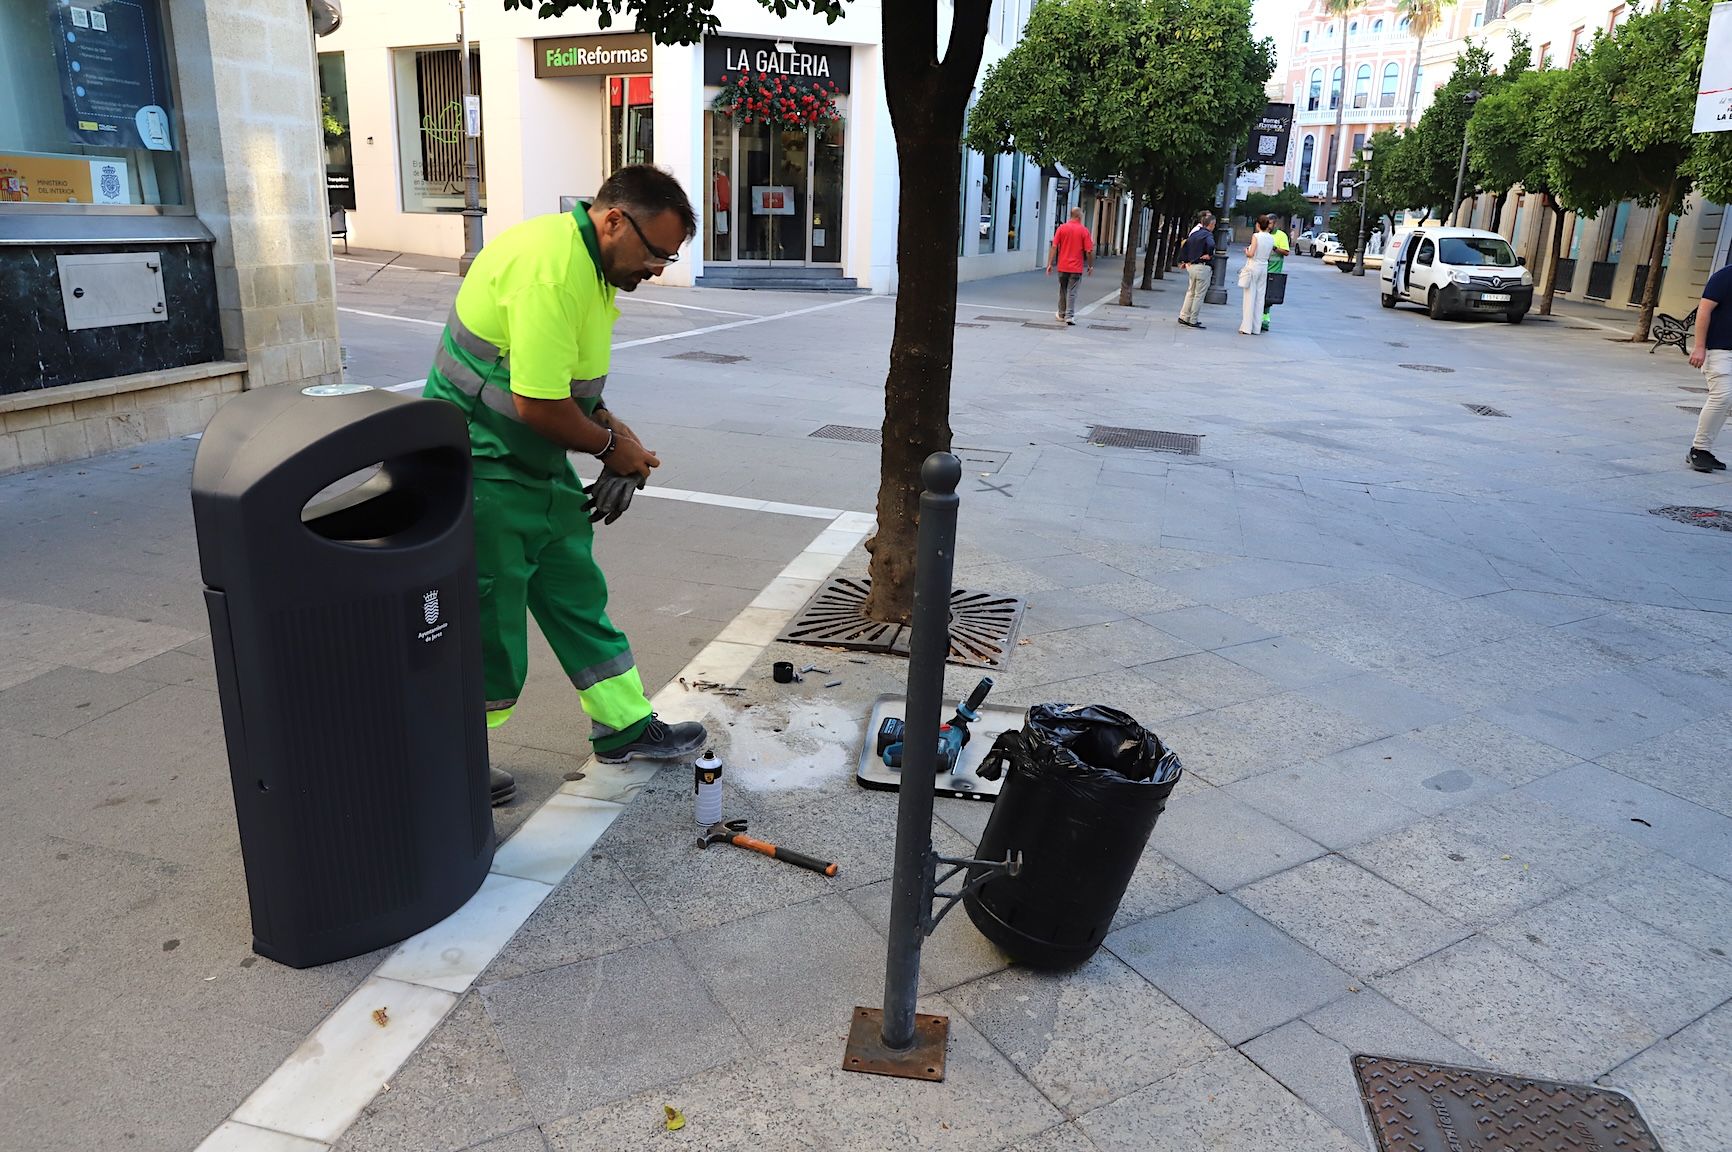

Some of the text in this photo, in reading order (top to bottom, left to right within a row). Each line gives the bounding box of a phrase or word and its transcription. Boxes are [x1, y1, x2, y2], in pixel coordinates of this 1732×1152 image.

[546, 45, 648, 67] FácilReformas
[727, 47, 830, 78] LA GALERIA
